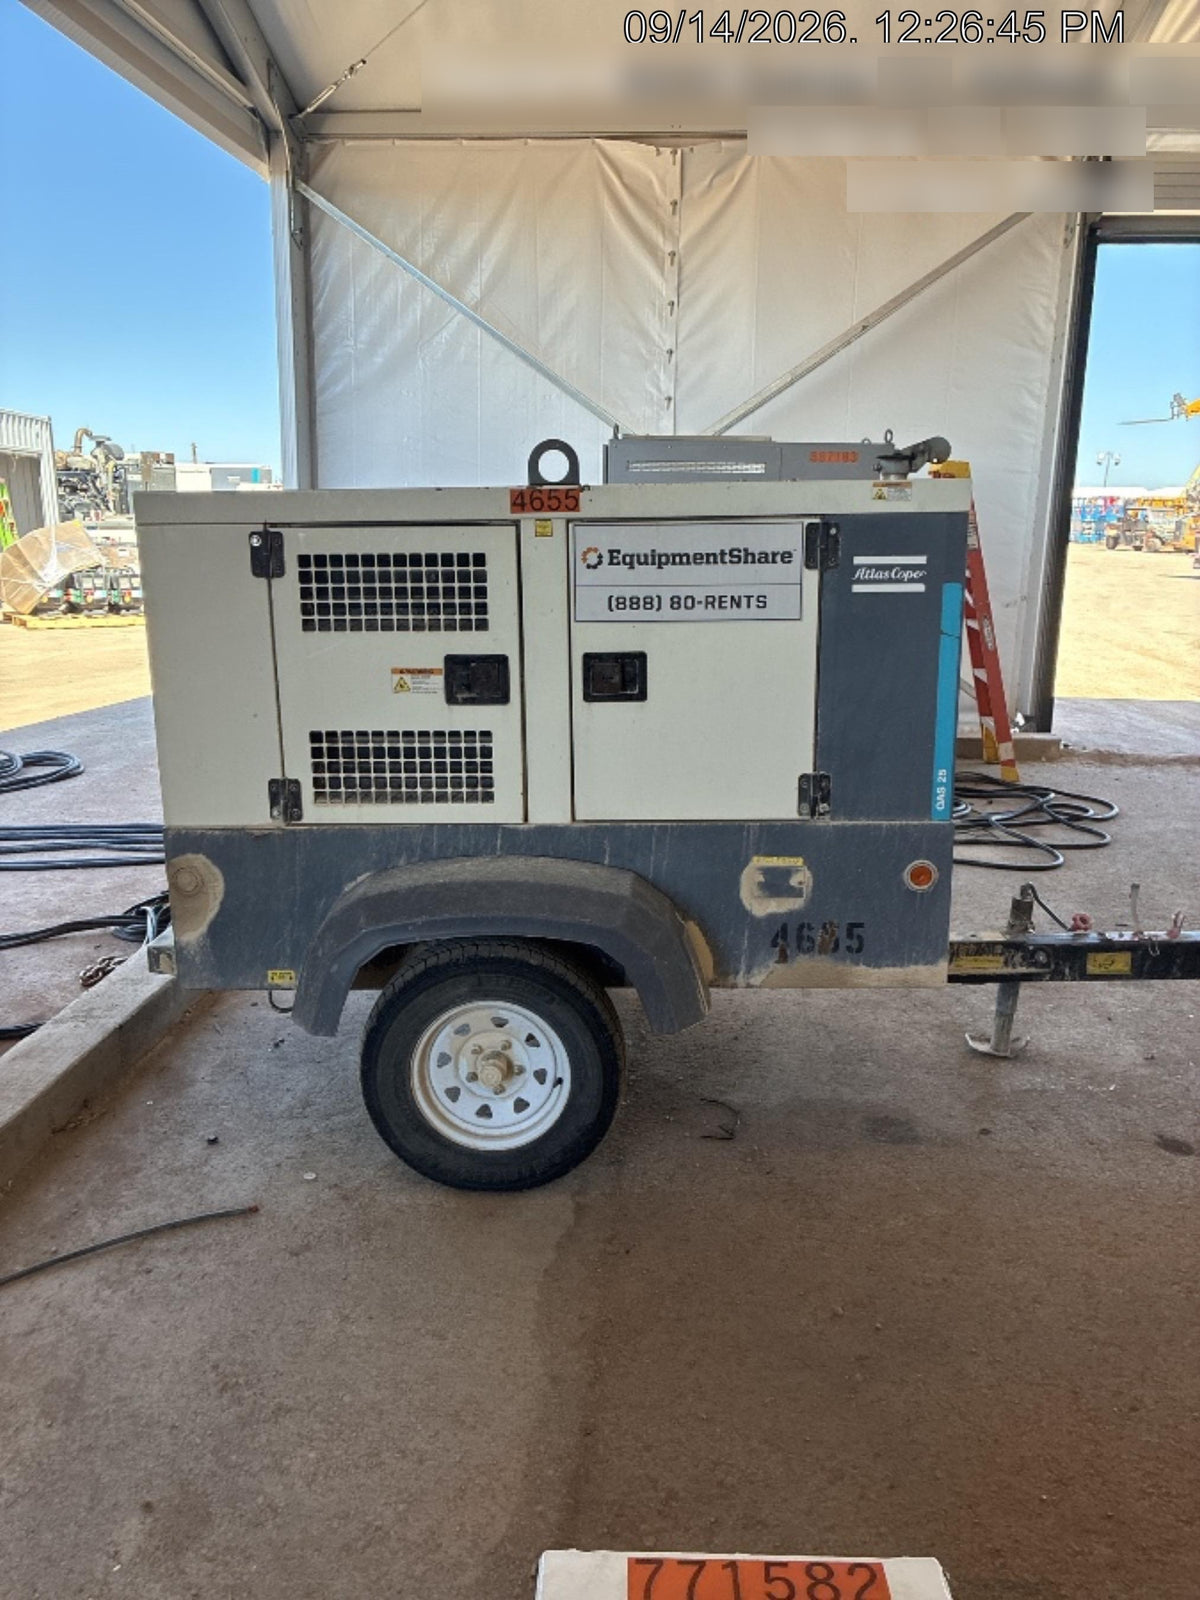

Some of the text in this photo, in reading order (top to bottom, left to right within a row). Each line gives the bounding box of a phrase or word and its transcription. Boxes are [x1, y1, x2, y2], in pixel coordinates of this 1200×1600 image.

[511, 488, 578, 511] 4655
[607, 547, 793, 569] EquipmentShare
[851, 566, 890, 581] Atlas
[607, 594, 768, 611] (888) 80-RENTS
[634, 1558, 877, 1600] 771582
